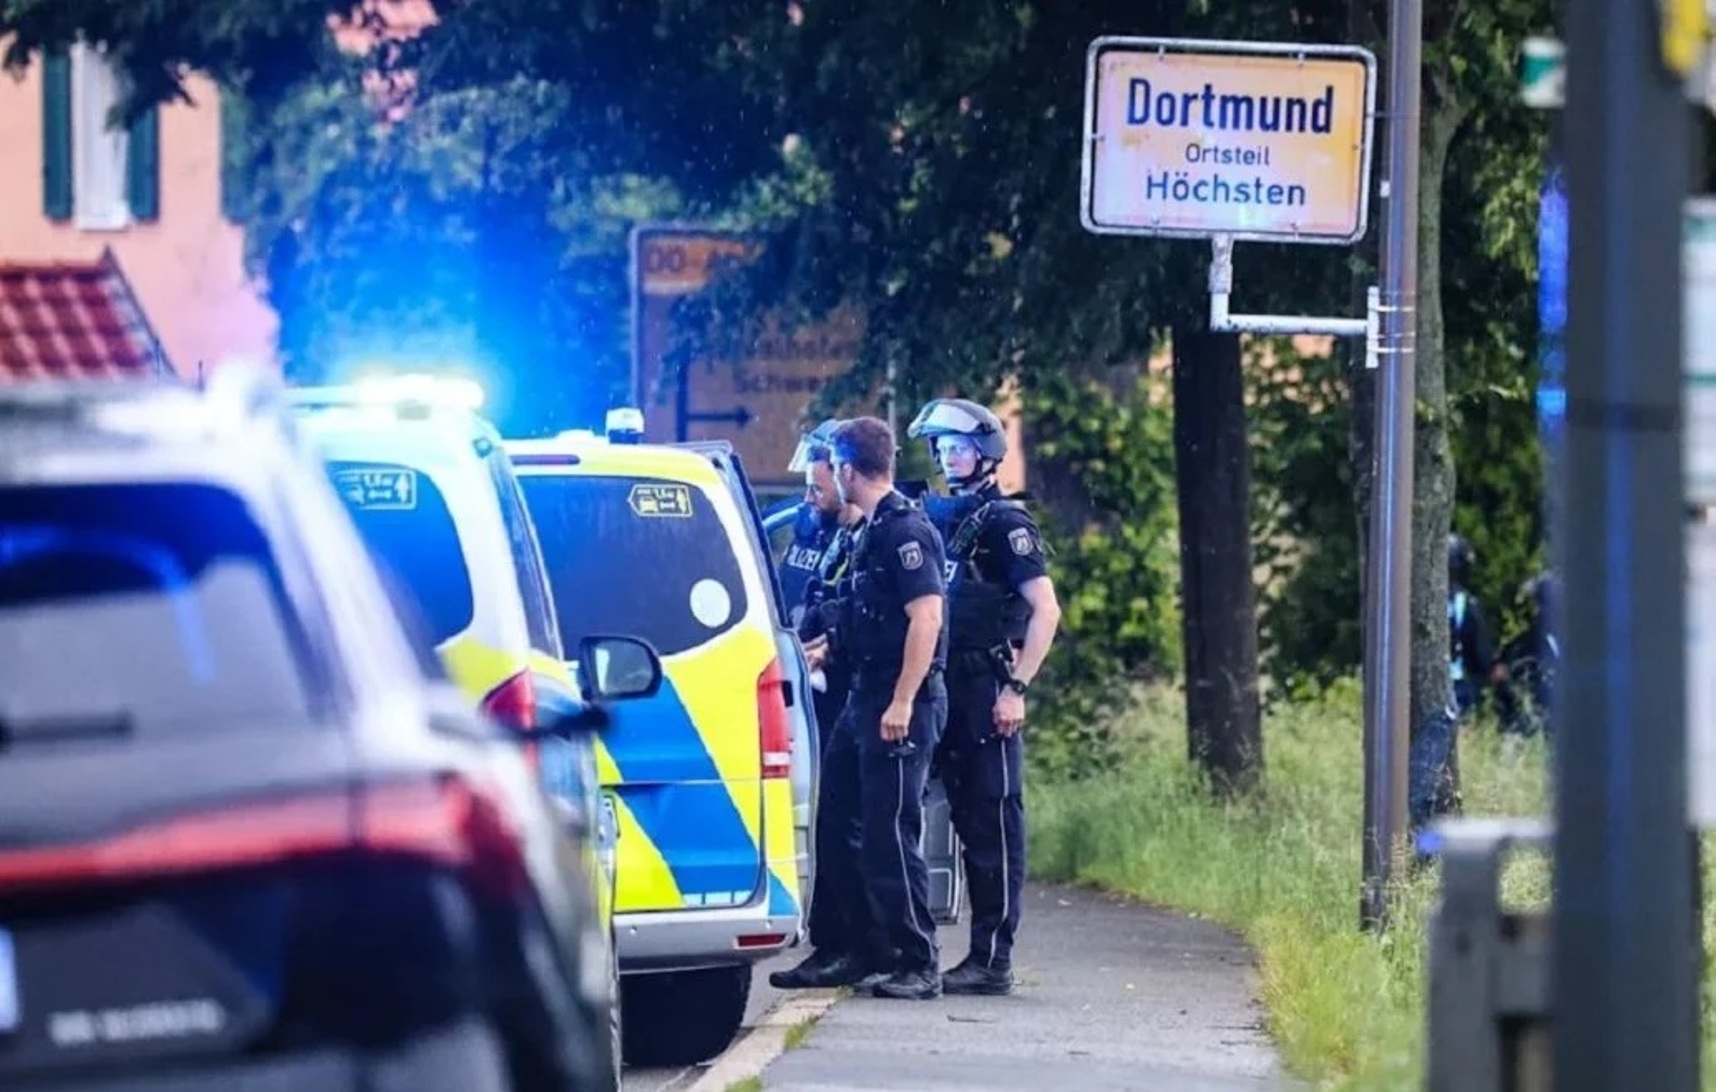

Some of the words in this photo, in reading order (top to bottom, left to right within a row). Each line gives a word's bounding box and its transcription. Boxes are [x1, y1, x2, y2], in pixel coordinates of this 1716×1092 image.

[1126, 77, 1334, 134] Dortmund
[1185, 143, 1270, 166] Ortsteil
[1146, 170, 1306, 207] Höchsten
